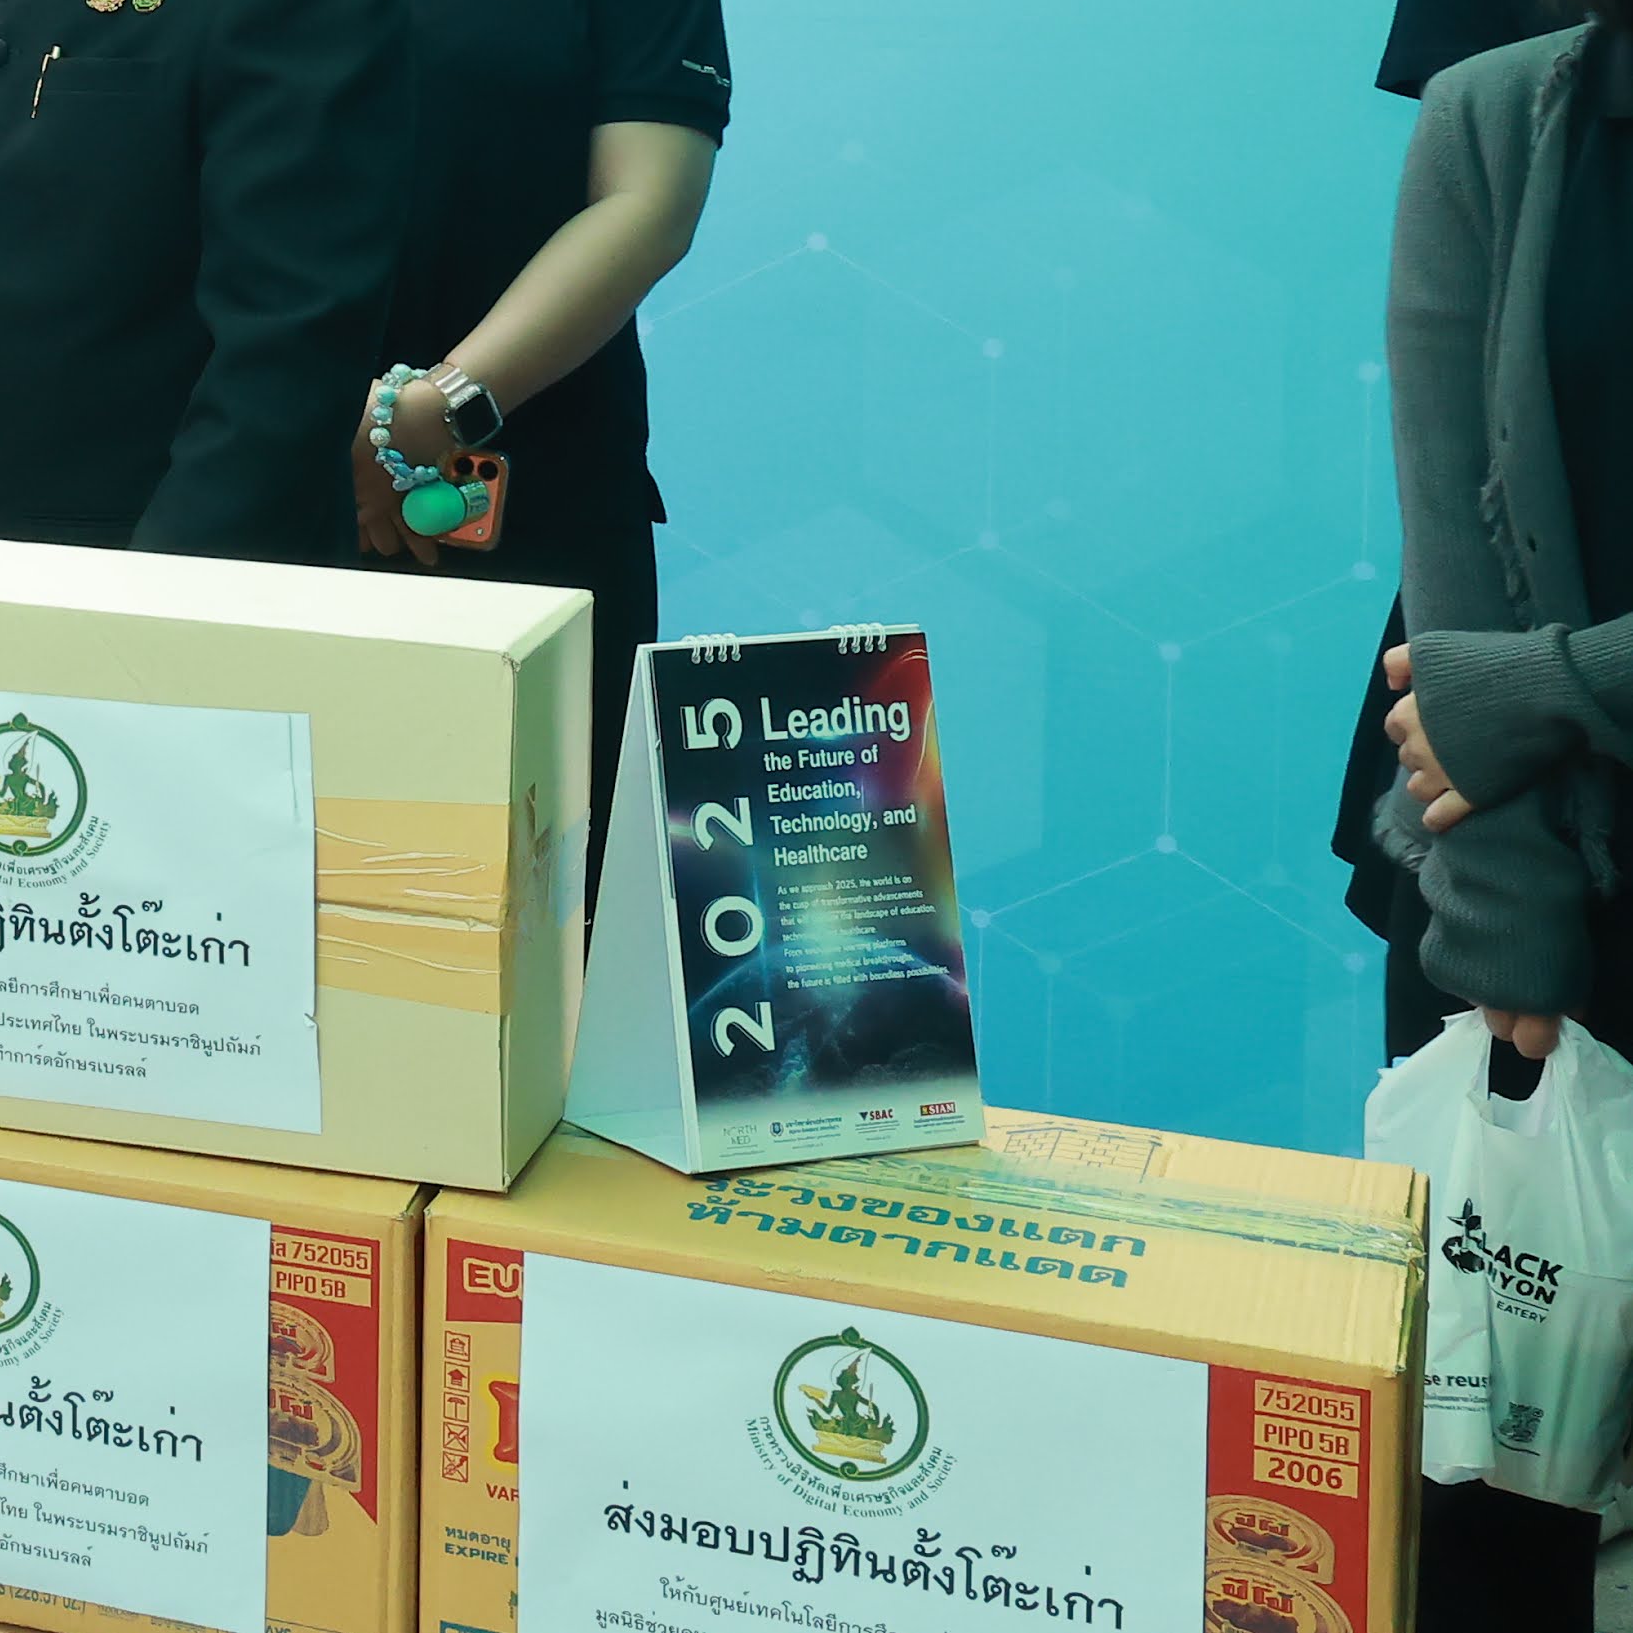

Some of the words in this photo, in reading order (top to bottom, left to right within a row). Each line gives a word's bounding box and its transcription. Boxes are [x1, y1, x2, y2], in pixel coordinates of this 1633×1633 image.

[761, 697, 911, 744] Leading
[764, 752, 792, 772] the
[798, 748, 855, 769] Future
[860, 745, 880, 764] of
[768, 780, 861, 803] Education,
[770, 809, 878, 837] Technology,
[884, 804, 916, 825] and
[17, 873, 67, 888] Economy
[71, 858, 87, 877] and
[86, 820, 111, 859] Society
[773, 844, 868, 867] Healthcare
[777, 886, 787, 895] As
[860, 878, 871, 887] the
[873, 877, 893, 886] world
[902, 876, 912, 884] on
[779, 901, 790, 910] the
[874, 890, 924, 902] advancements
[854, 908, 888, 919] landscape
[890, 906, 899, 916] of
[787, 980, 799, 989] the
[802, 977, 823, 987] future
[854, 972, 868, 982] with
[870, 969, 905, 981] boundless
[87, 1018, 261, 1058] ในพระบรมราชินูปถัมภ์
[870, 1108, 893, 1120] SBAC
[929, 1103, 955, 1115] SIAM
[290, 1240, 370, 1272] 752055
[686, 1194, 1128, 1289] ห้ามตากแดด
[275, 1270, 318, 1296] PIPO
[321, 1278, 347, 1300] 5B
[1496, 1300, 1547, 1324] EATERY
[23, 1343, 41, 1360] and
[39, 1306, 65, 1343] Society
[1260, 1387, 1354, 1421] 752055
[1264, 1423, 1312, 1450] PIPO
[1319, 1433, 1350, 1456] 5B
[745, 1419, 776, 1471] Ministry
[777, 1473, 792, 1486] of
[792, 1484, 836, 1512] Digital
[843, 1504, 903, 1518] Economy
[908, 1491, 929, 1510] and
[927, 1452, 957, 1492] Society
[1268, 1457, 1343, 1490] 2006
[33, 1501, 209, 1555] ในพระบรมราชินูปถัมภ์
[445, 1524, 512, 1555] หมดอายุ
[444, 1543, 510, 1566] EXPIRE
[604, 1480, 1124, 1630] ส่งมอบปฏิทินตั้งโต๊ะเก่า
